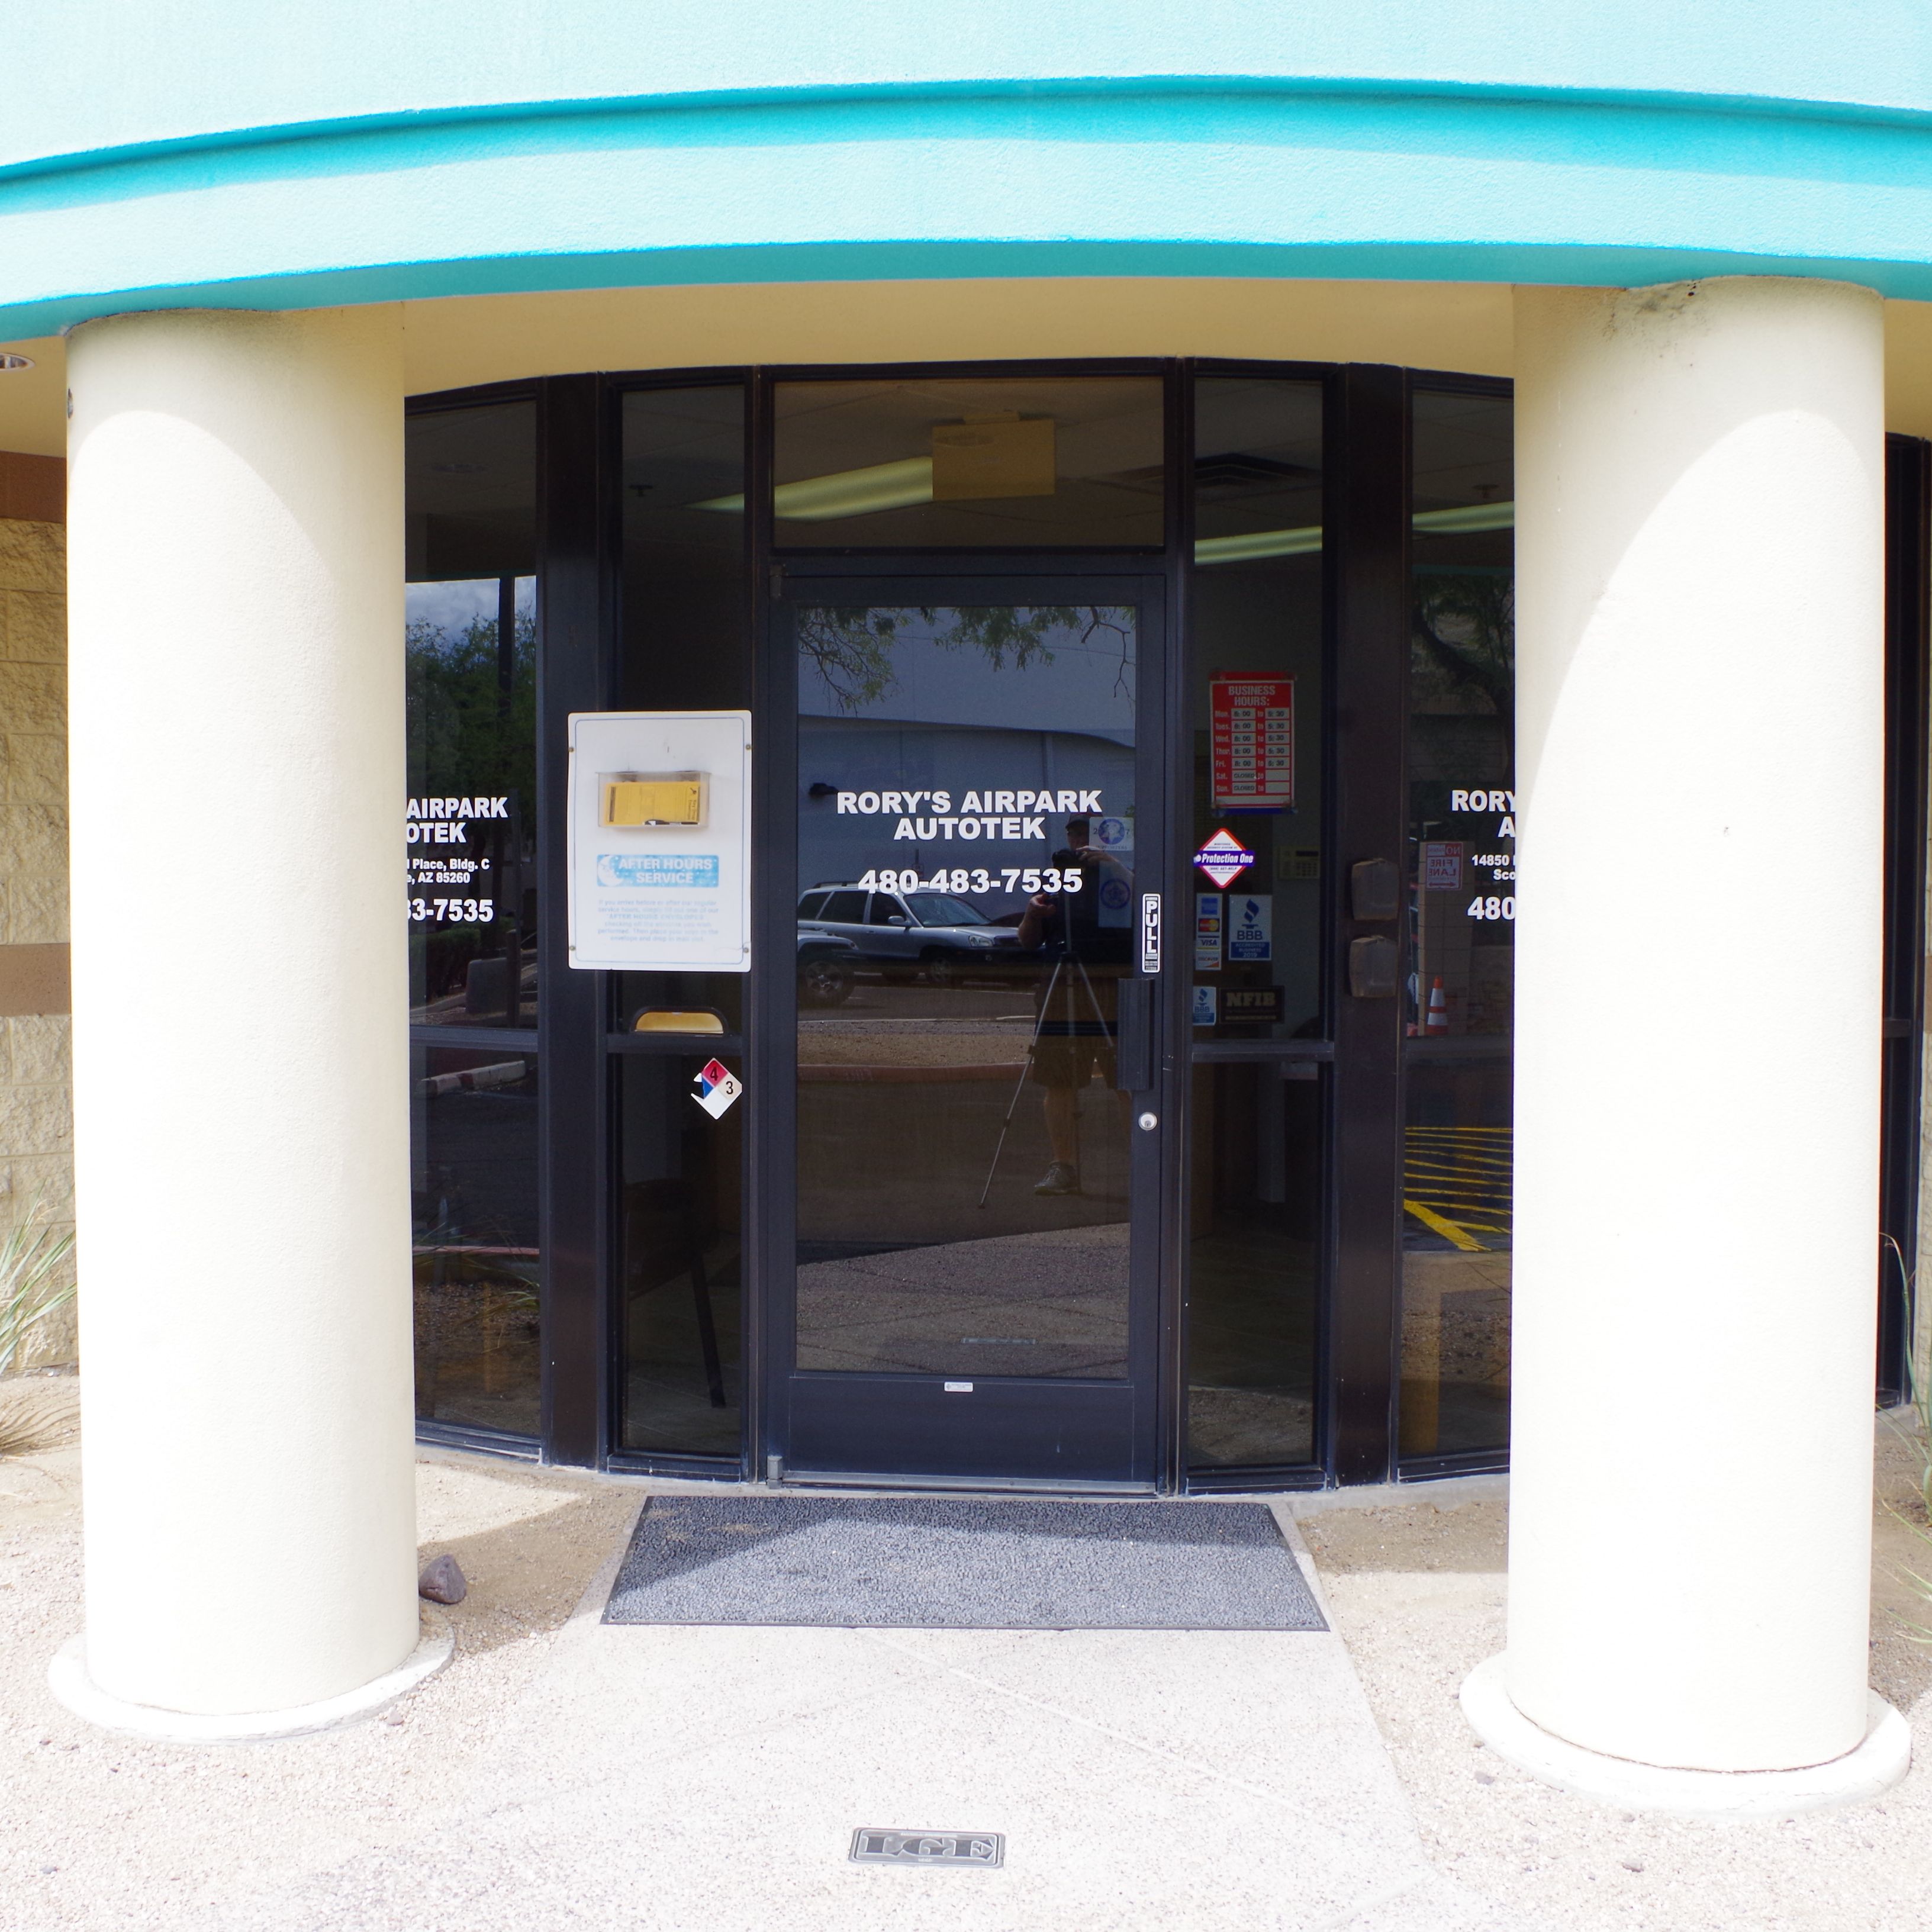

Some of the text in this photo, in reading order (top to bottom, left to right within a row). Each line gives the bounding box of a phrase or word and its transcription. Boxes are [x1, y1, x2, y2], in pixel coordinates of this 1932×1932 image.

[1228, 685, 1276, 696] BUSINESS
[1234, 696, 1270, 706] HOURS:
[407, 797, 508, 819] AIRPARK
[836, 790, 1103, 814] RORY'S AIRPARK
[893, 817, 1046, 840] AUTOTEK
[619, 858, 713, 870] AFTER HOURS
[1202, 853, 1254, 863] Protection One
[1471, 854, 1509, 866] 14850
[413, 858, 446, 871] Place,
[450, 858, 478, 872] Bldg.
[481, 858, 490, 870] C
[418, 872, 433, 883] AZ
[436, 872, 471, 884] 85260
[636, 872, 693, 883] SERVICE
[858, 868, 1083, 894] 480-483-7535
[1145, 900, 1158, 954] PULL
[1237, 930, 1263, 940] BBB
[1226, 992, 1276, 1007] NFIB
[710, 1067, 718, 1081] 4
[726, 1081, 733, 1094] 3
